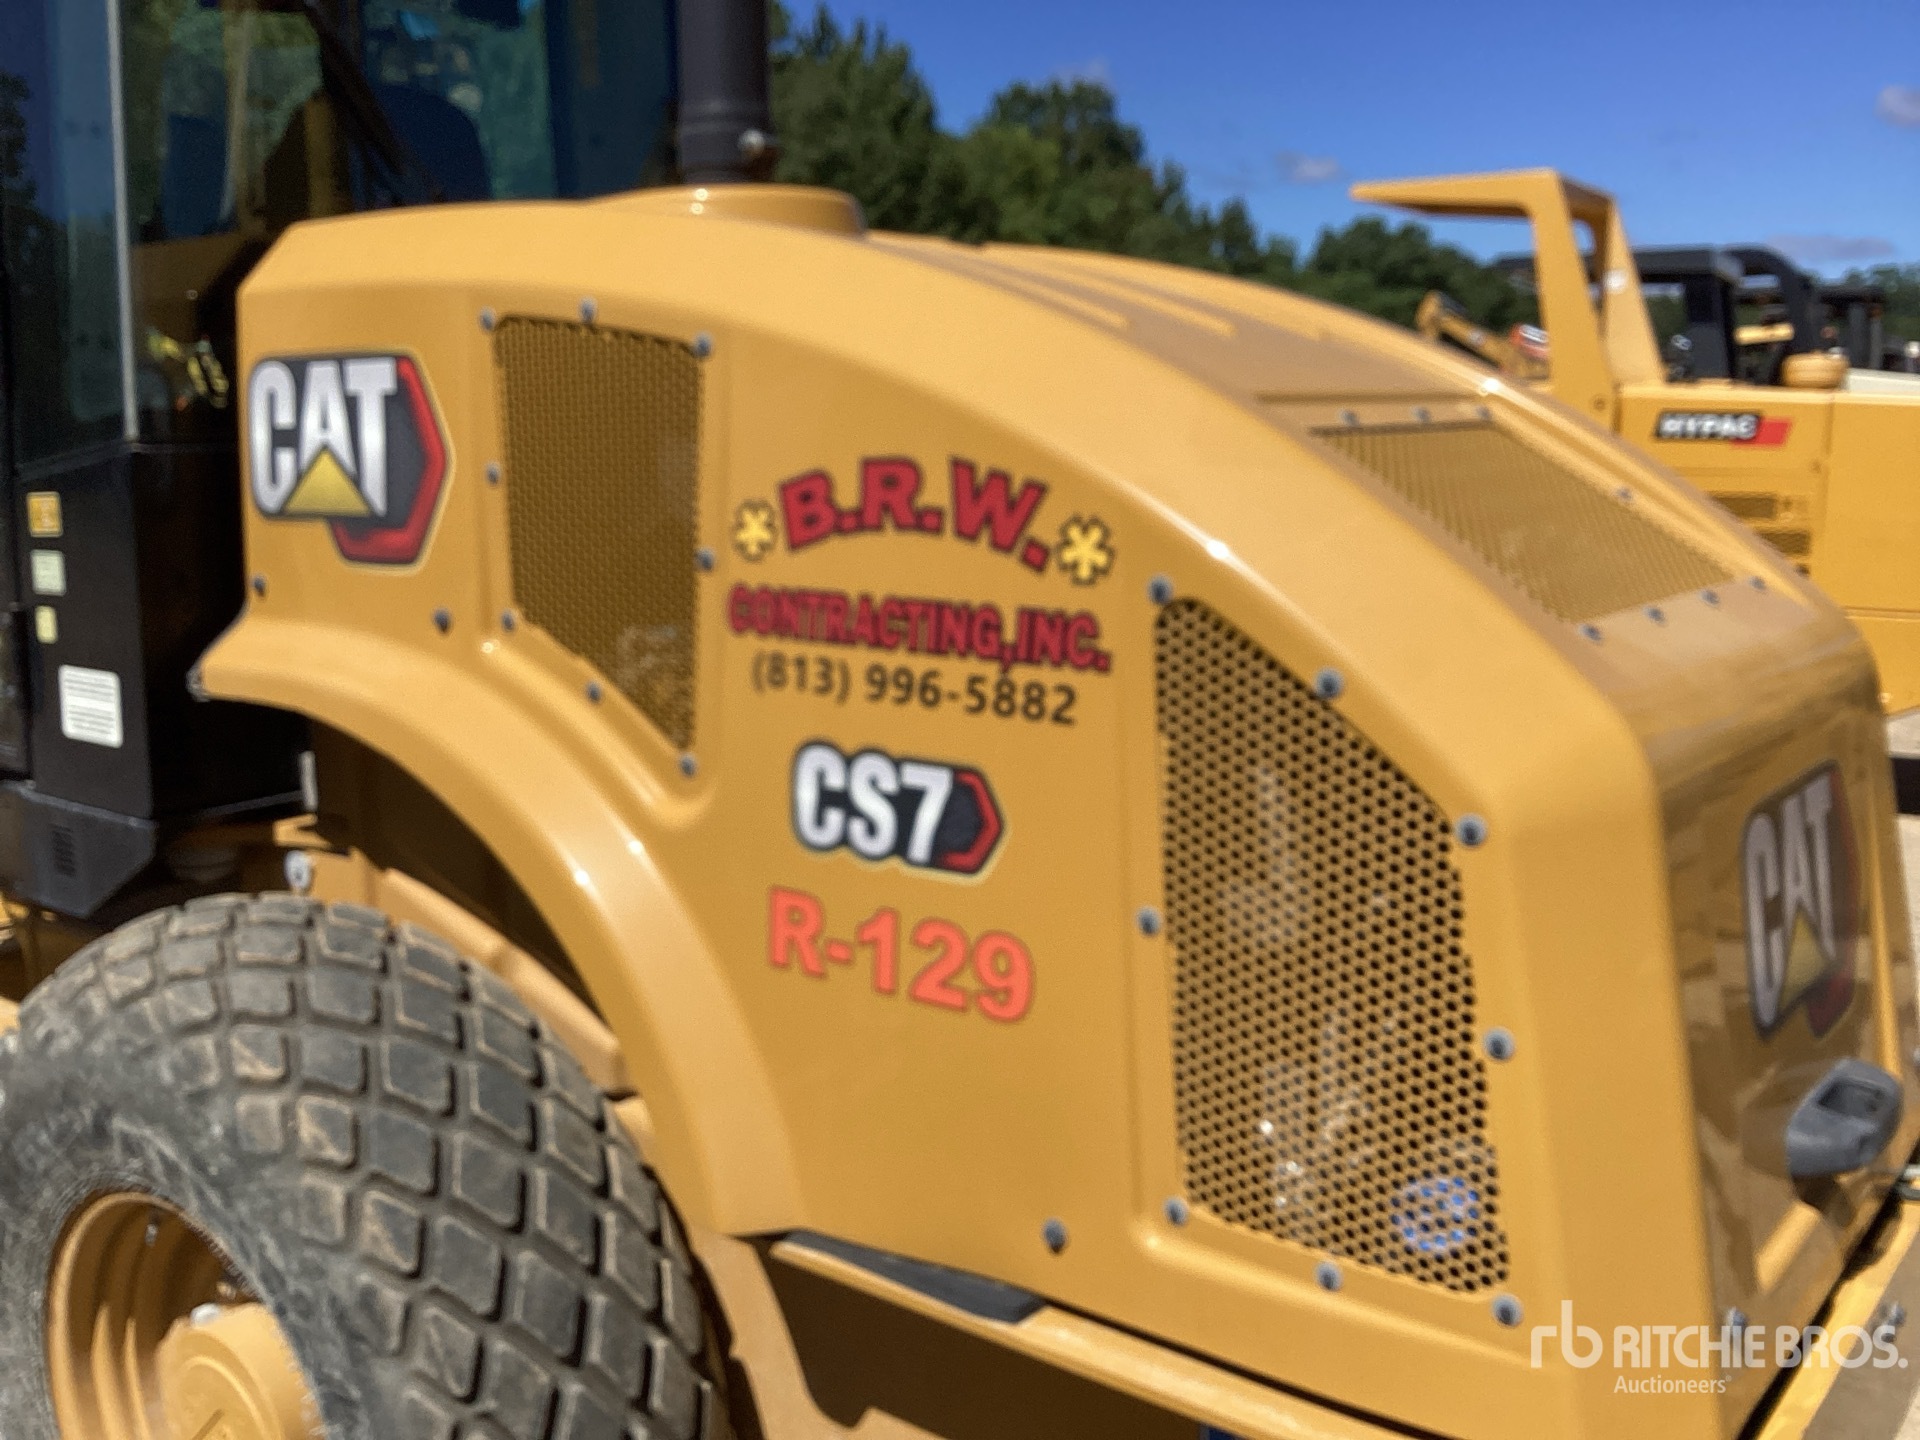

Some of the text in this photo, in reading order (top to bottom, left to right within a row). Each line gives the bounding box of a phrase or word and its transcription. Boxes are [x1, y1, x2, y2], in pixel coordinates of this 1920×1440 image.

[248, 356, 398, 518] CAT
[1659, 412, 1758, 440] HYPAC
[779, 454, 1051, 573] B.R.W.
[751, 650, 1079, 726] (813) 996-5882
[791, 742, 954, 866] CS7
[767, 884, 1036, 1024] R-129
[1745, 772, 1837, 1027] CAT
